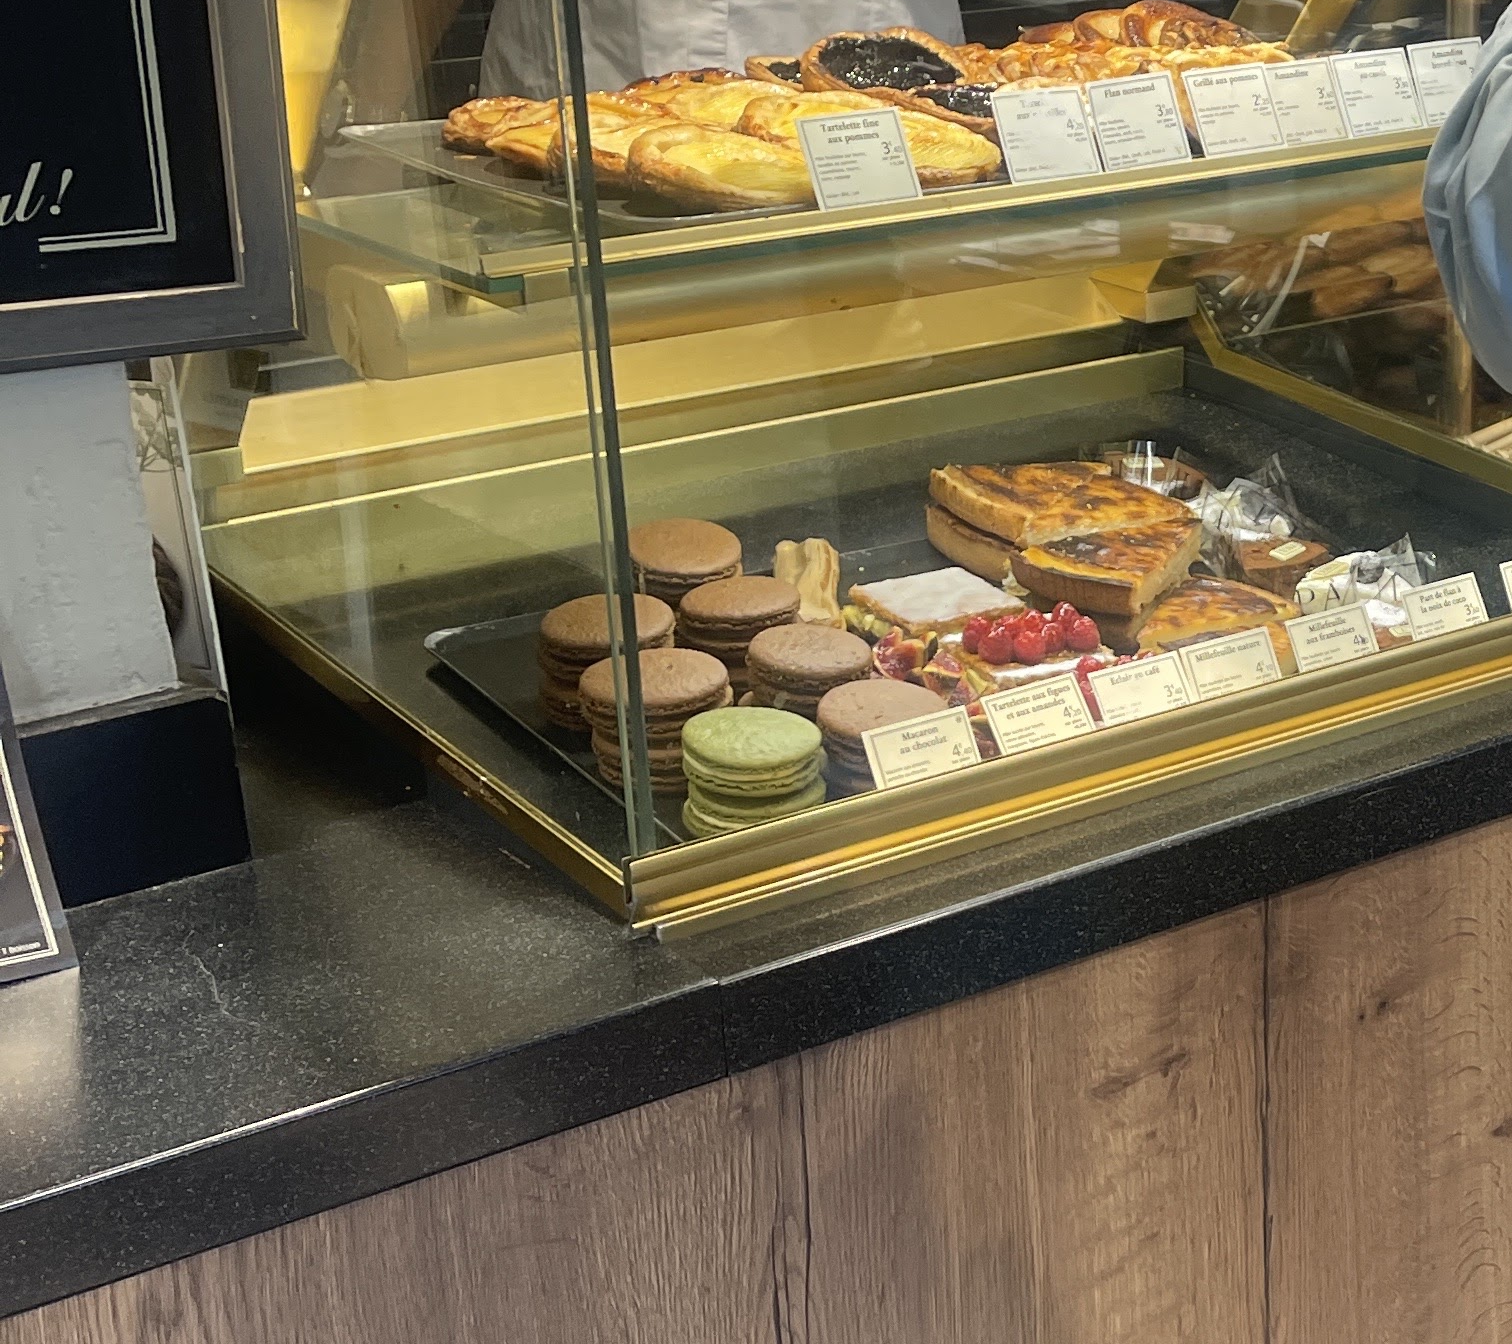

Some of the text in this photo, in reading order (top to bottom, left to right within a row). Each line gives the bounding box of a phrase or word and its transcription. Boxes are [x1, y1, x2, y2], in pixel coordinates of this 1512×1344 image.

[1215, 77, 1228, 86] aux
[1229, 73, 1258, 86] pommes
[1274, 69, 1309, 80] Amandine
[1104, 82, 1156, 98] Flan normand
[820, 118, 880, 133] Tartelette fine
[827, 132, 880, 144] aux pommes
[1419, 594, 1434, 604] Part
[1435, 590, 1443, 600] de
[1442, 587, 1457, 597] flan
[1420, 595, 1467, 614] la noix de coco
[1306, 627, 1356, 645] aux framboises
[1195, 640, 1261, 663] Millefeuille nature
[1144, 664, 1161, 677] café
[991, 684, 1071, 712] Tartelette aux figues
[1006, 697, 1066, 720] et aux amandes
[901, 726, 939, 741] Macaron
[899, 735, 948, 755] au chocolat
